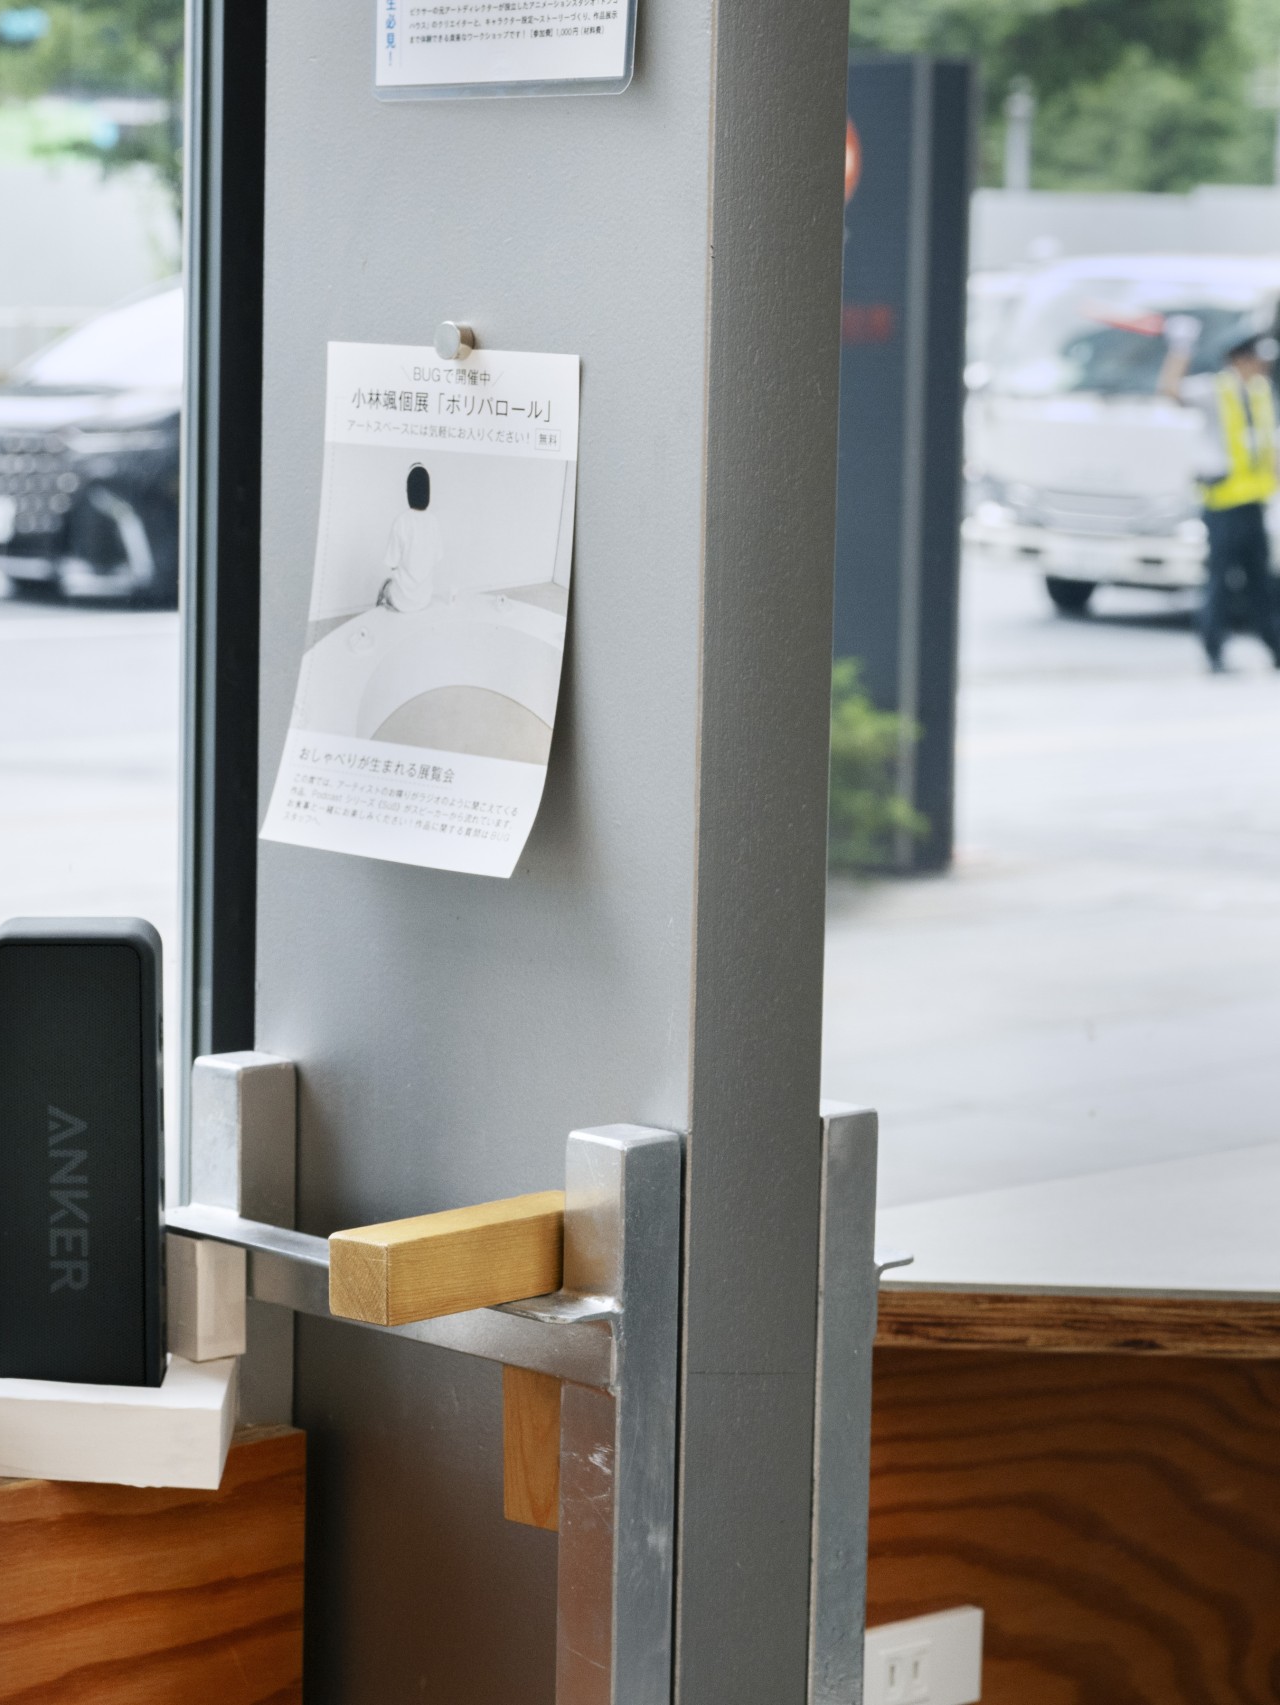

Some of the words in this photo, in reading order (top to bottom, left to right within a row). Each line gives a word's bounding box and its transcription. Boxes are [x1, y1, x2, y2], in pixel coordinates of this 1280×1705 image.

[351, 387, 551, 422] 小林颯個展「ポリパロール」
[347, 419, 529, 444] アートスペースには気軽にお入りください！
[538, 432, 558, 446] 無料
[299, 747, 455, 783] おしゃべりが生まれる展覧会
[48, 1105, 90, 1294] ANKER
